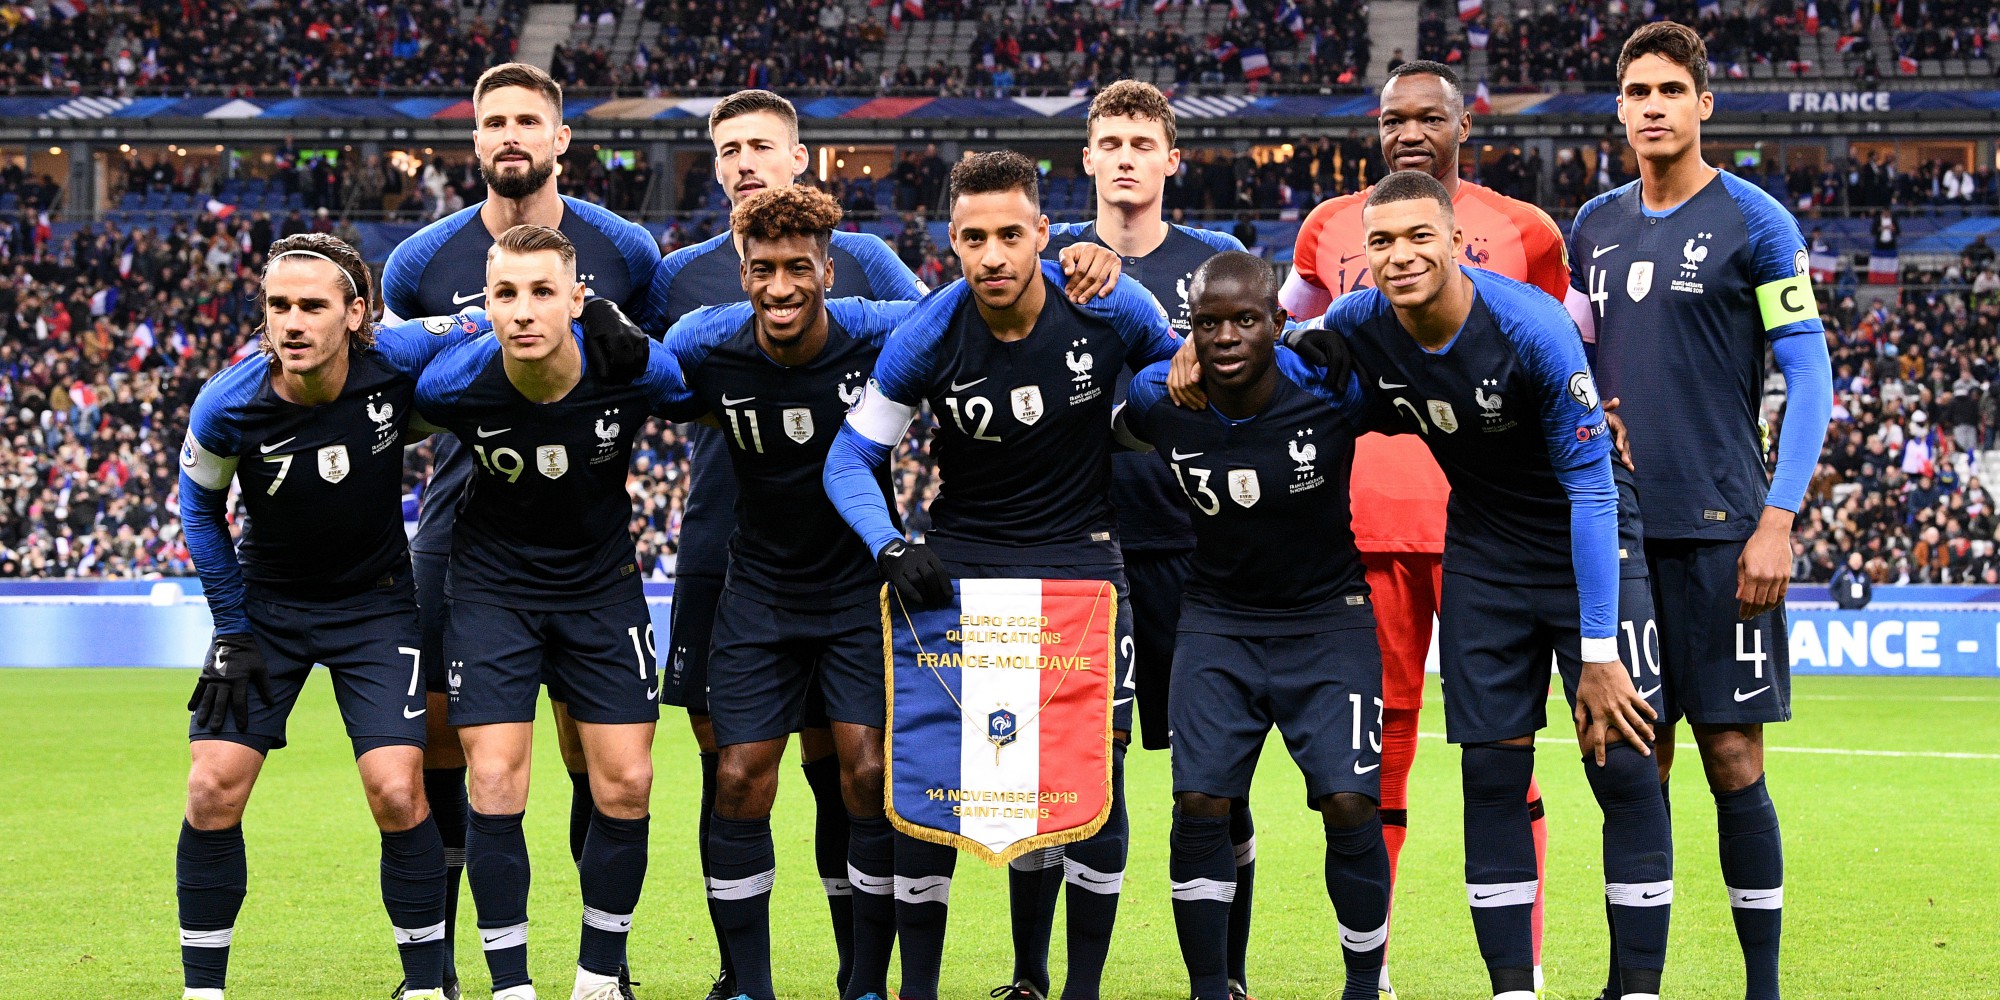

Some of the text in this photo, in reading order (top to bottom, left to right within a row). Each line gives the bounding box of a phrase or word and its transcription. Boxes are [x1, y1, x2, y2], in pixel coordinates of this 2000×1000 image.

[1788, 91, 1891, 112] FRANCE
[1589, 265, 1609, 318] 4
[1780, 286, 1805, 312] C
[725, 408, 764, 454] 11
[945, 396, 1002, 443] 12
[264, 454, 294, 497] 7
[473, 444, 525, 484] 19
[1297, 471, 1315, 481] FFF
[1170, 462, 1220, 516] 13
[945, 629, 1061, 645] QUALIFICATIONS
[959, 614, 1049, 627] EURO 2020
[916, 653, 1091, 671] FRANCE-MOLDAVIE
[1116, 635, 1136, 690] 2
[1620, 619, 1661, 678] 10
[1736, 623, 1767, 678] 4
[1789, 620, 1941, 668] ANCE
[397, 646, 421, 696] 7
[1349, 693, 1384, 754] 13
[925, 788, 1078, 804] 14 NOVEMBRE 2019
[952, 805, 1050, 819] SAINT-DENIS
